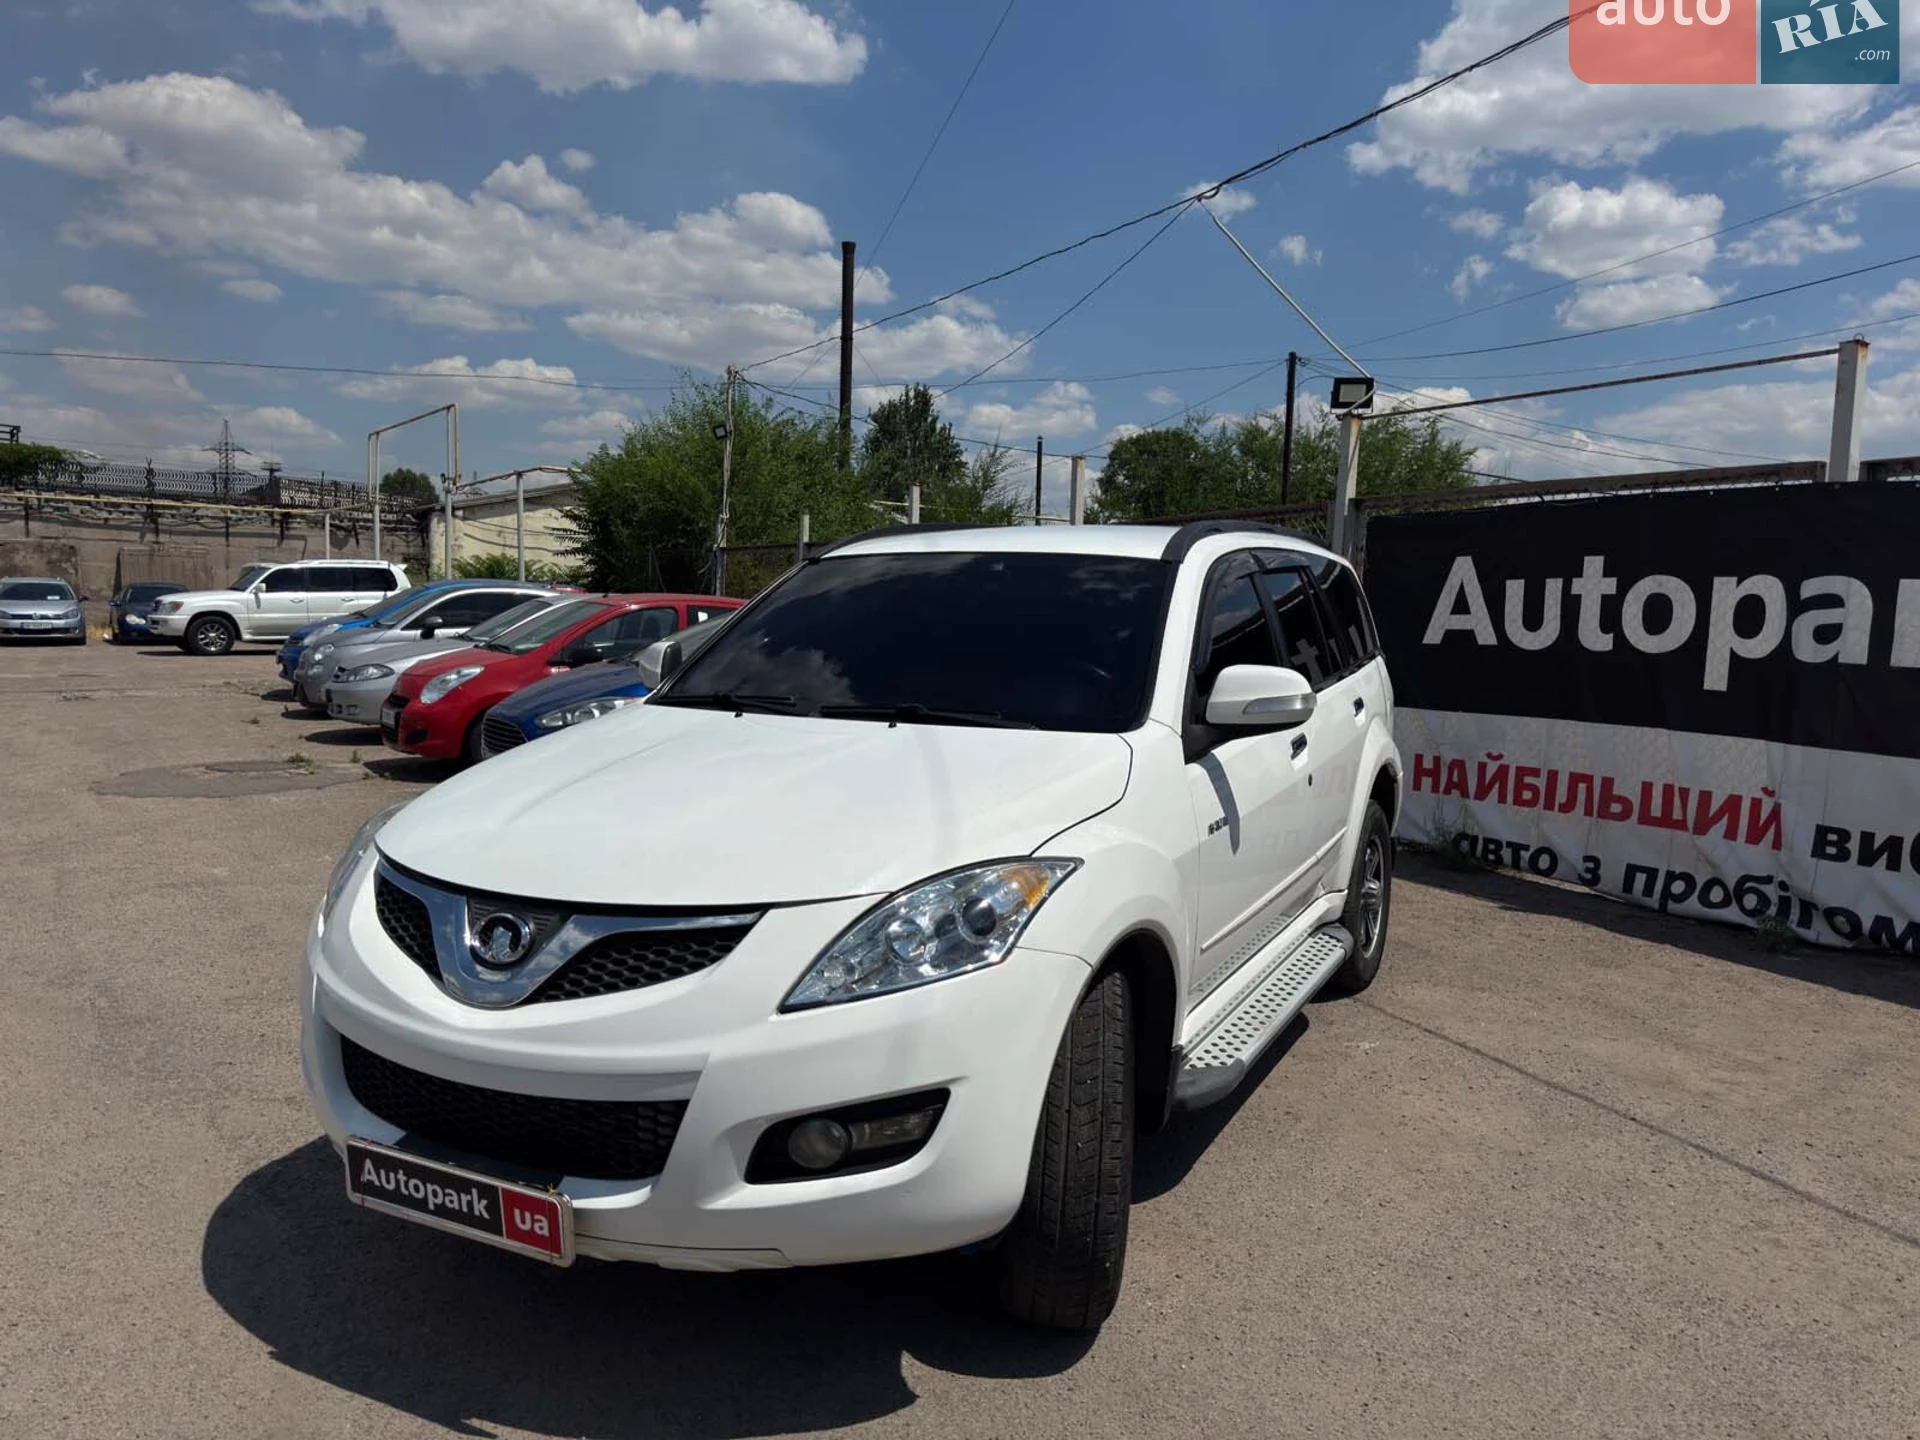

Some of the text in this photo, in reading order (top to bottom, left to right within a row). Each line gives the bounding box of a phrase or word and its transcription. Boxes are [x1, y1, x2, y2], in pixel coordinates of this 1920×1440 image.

[1412, 751, 1920, 877] НАЙБІЛЬШИЙ ви
[1453, 832, 1559, 877] авто
[362, 1157, 550, 1238] Autopark ua
